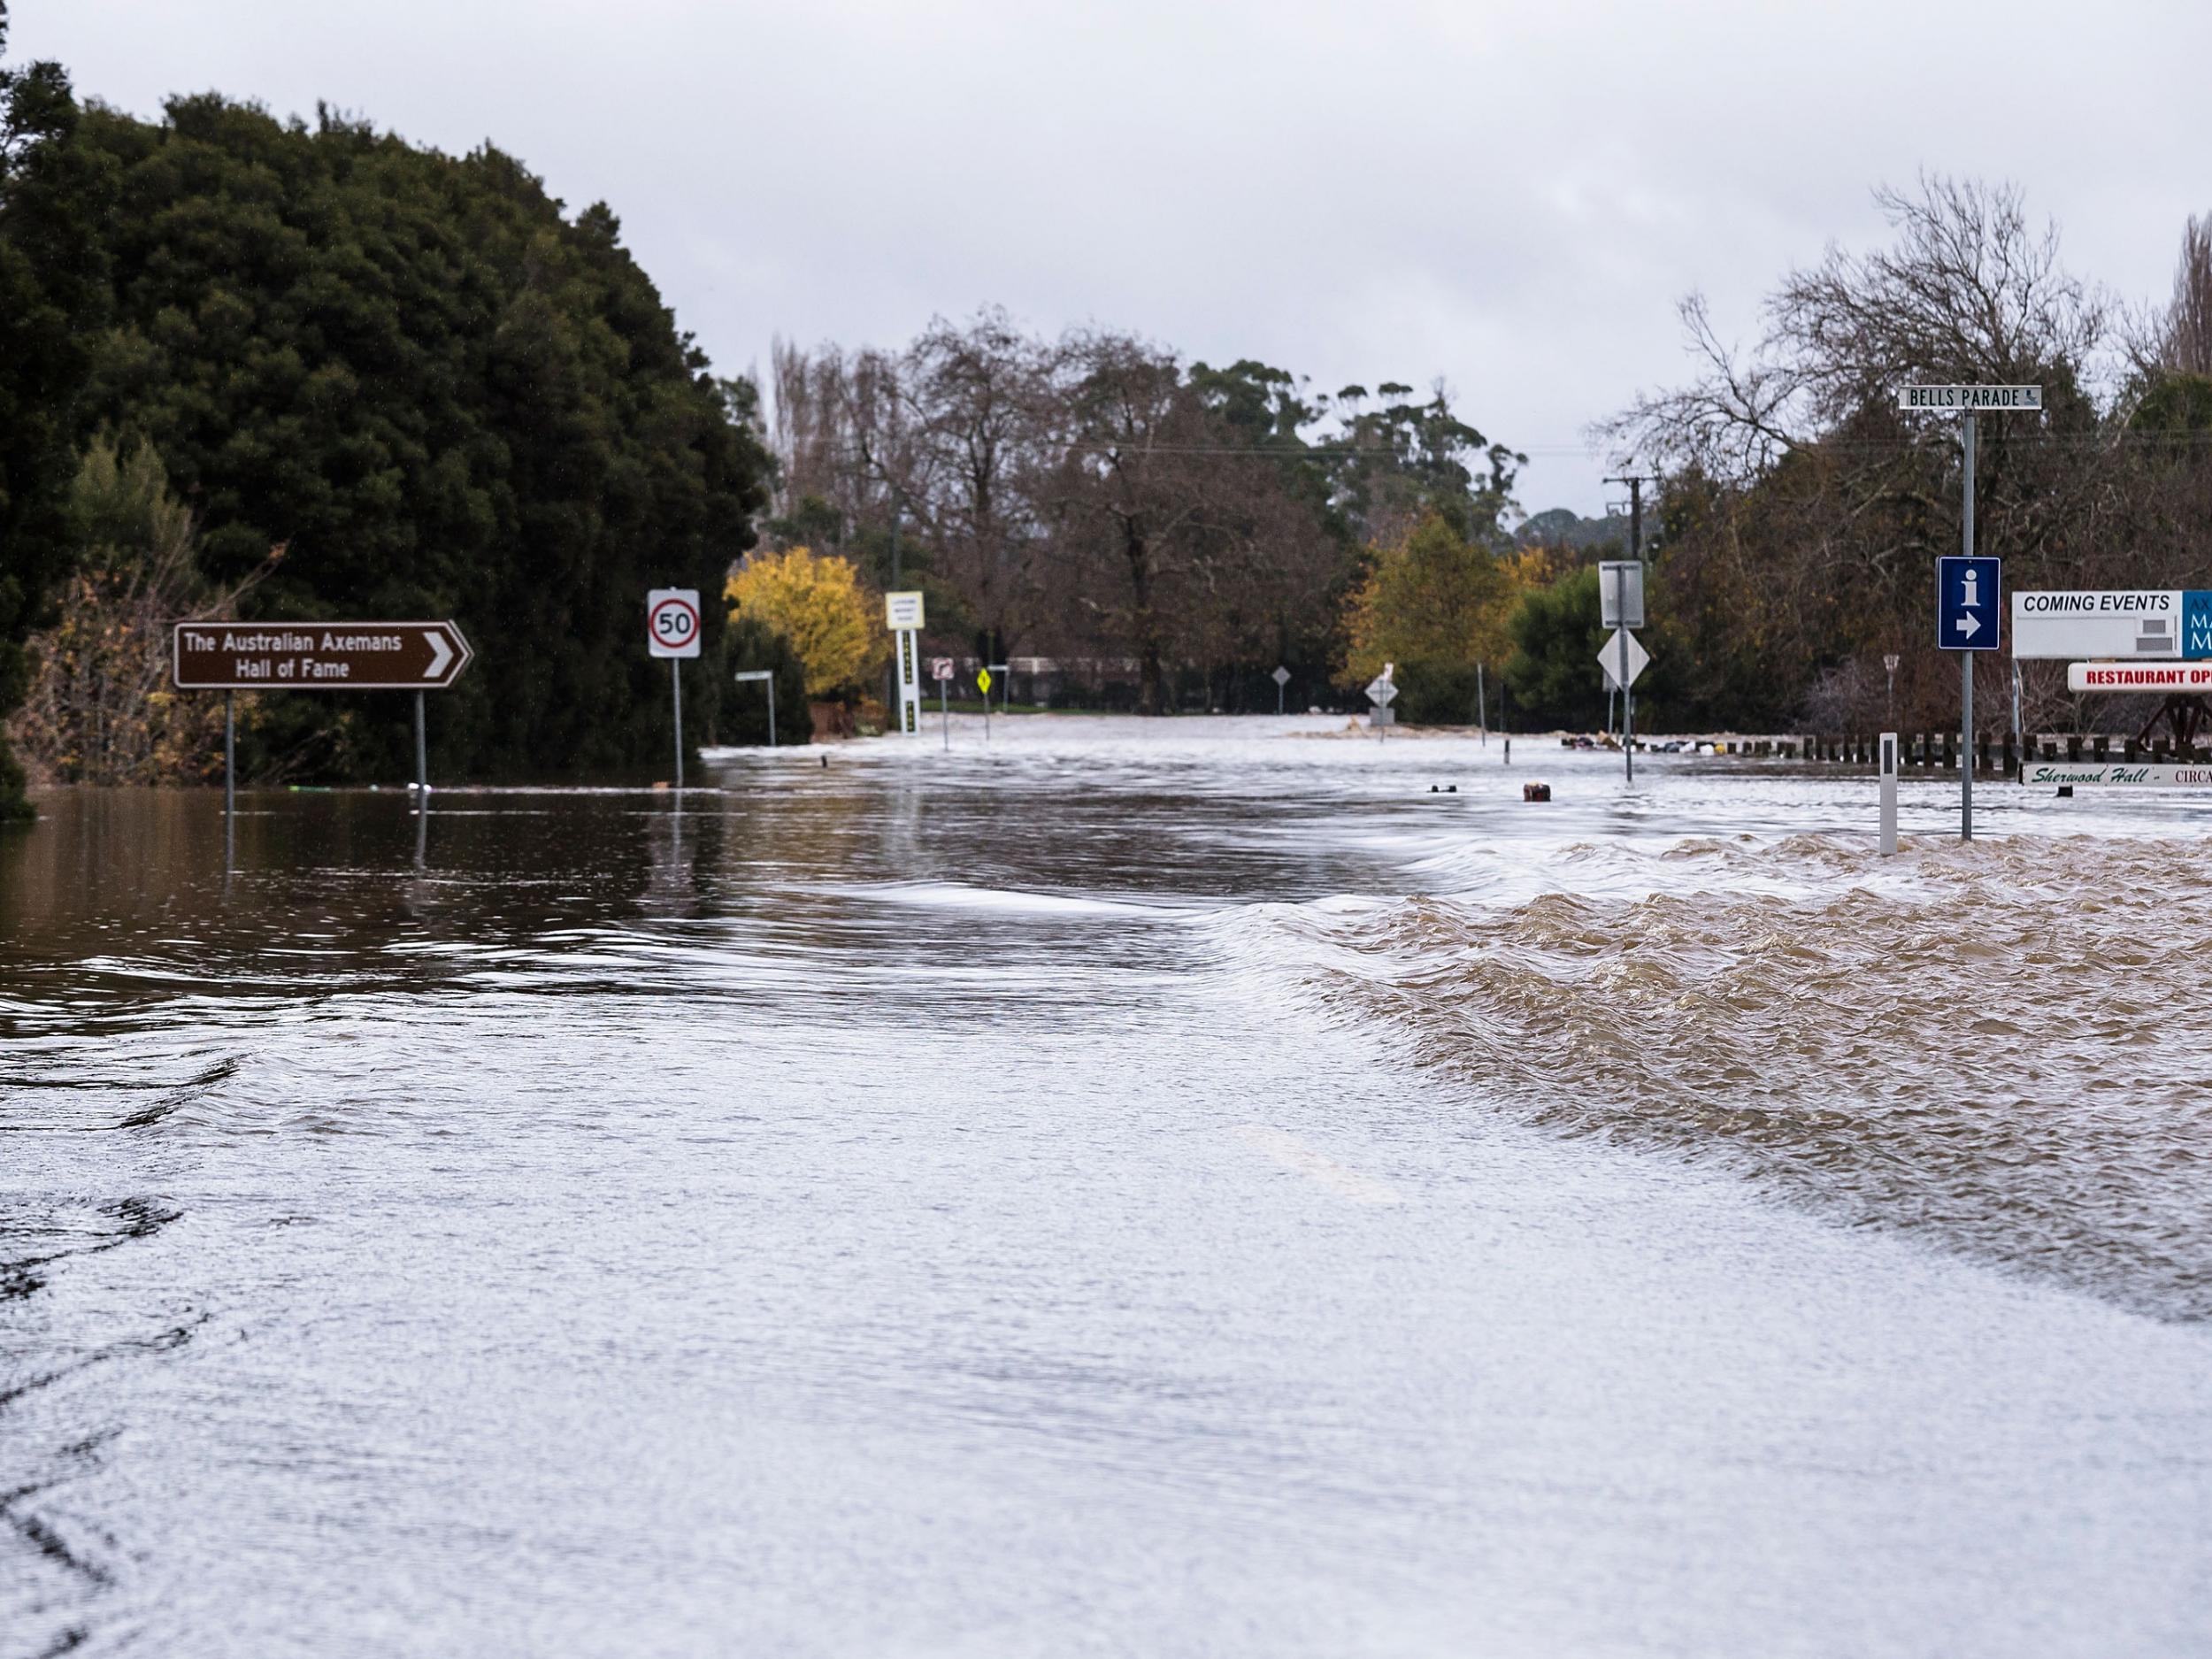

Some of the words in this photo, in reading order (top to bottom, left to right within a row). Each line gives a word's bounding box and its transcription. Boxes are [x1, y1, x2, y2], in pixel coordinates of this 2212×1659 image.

[1910, 389, 1954, 406] BELLS
[1962, 389, 2019, 406] PARADE
[2024, 595, 2095, 611] COMING
[2100, 595, 2170, 611] EVENTS
[659, 613, 690, 634] 50
[184, 632, 216, 651] The
[222, 632, 314, 651] Australian
[320, 632, 403, 651] Axemans
[235, 658, 271, 678] Hall
[277, 658, 295, 678] of
[302, 658, 349, 678] Fame
[2086, 670, 2185, 684] RESTAURANT
[2190, 670, 2212, 684] OP
[2032, 767, 2107, 783] Sherwood
[2110, 767, 2149, 783] Hall
[2175, 770, 2212, 783] CIRCA
